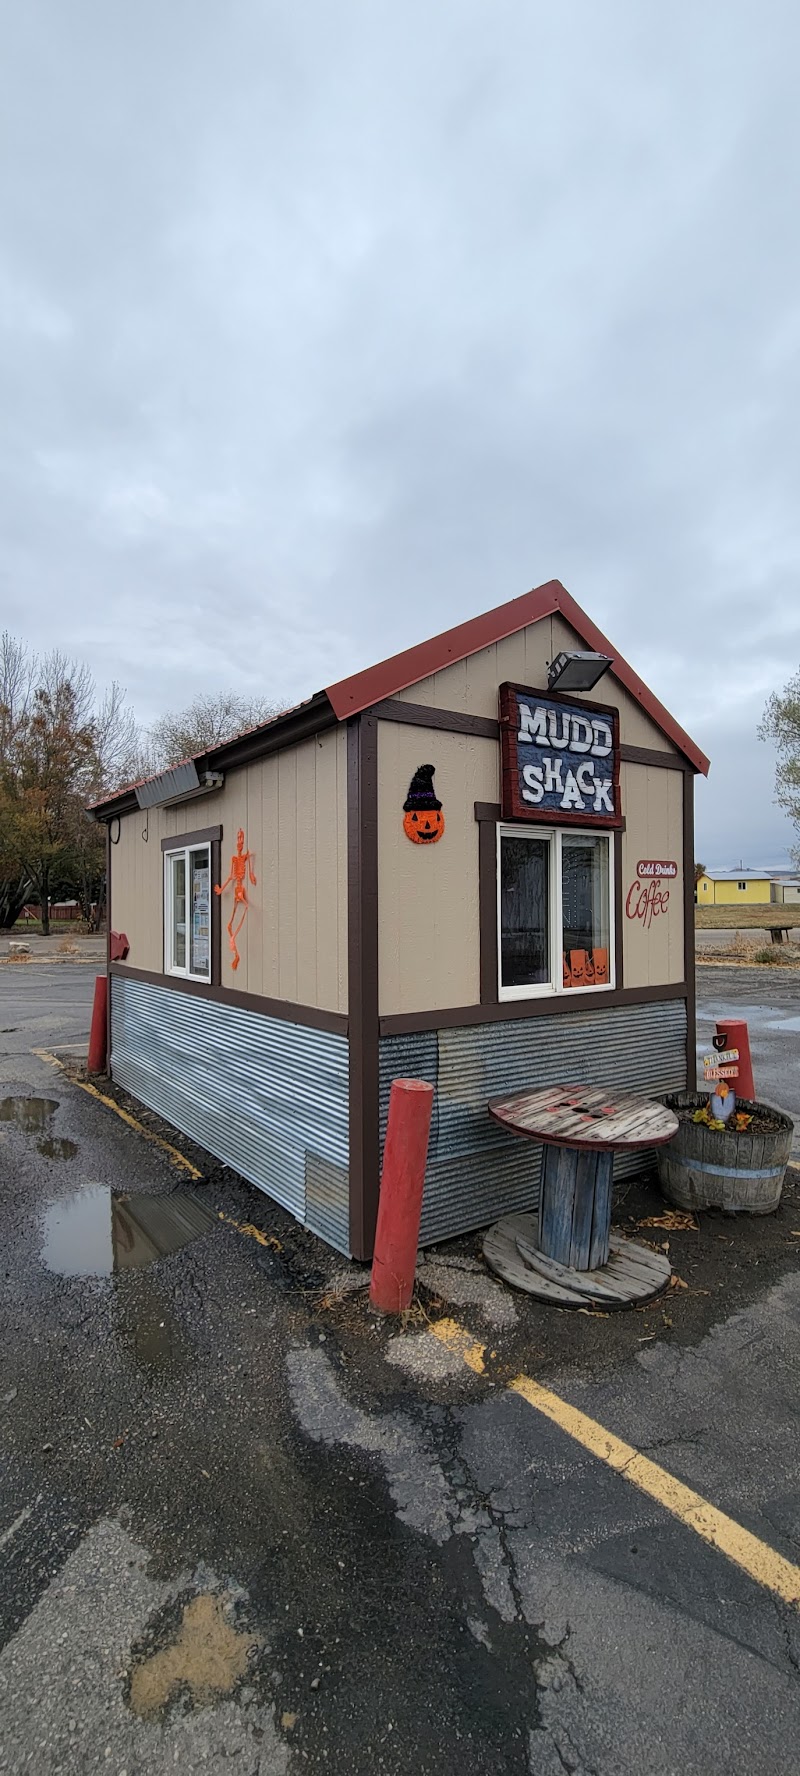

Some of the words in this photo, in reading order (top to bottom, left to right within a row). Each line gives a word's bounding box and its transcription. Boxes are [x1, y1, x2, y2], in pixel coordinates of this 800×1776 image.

[518, 703, 613, 757] MUDD
[522, 757, 615, 812] SHACK
[639, 863, 654, 875] Cold
[655, 863, 676, 876] Drinks
[625, 879, 670, 930] Coffee
